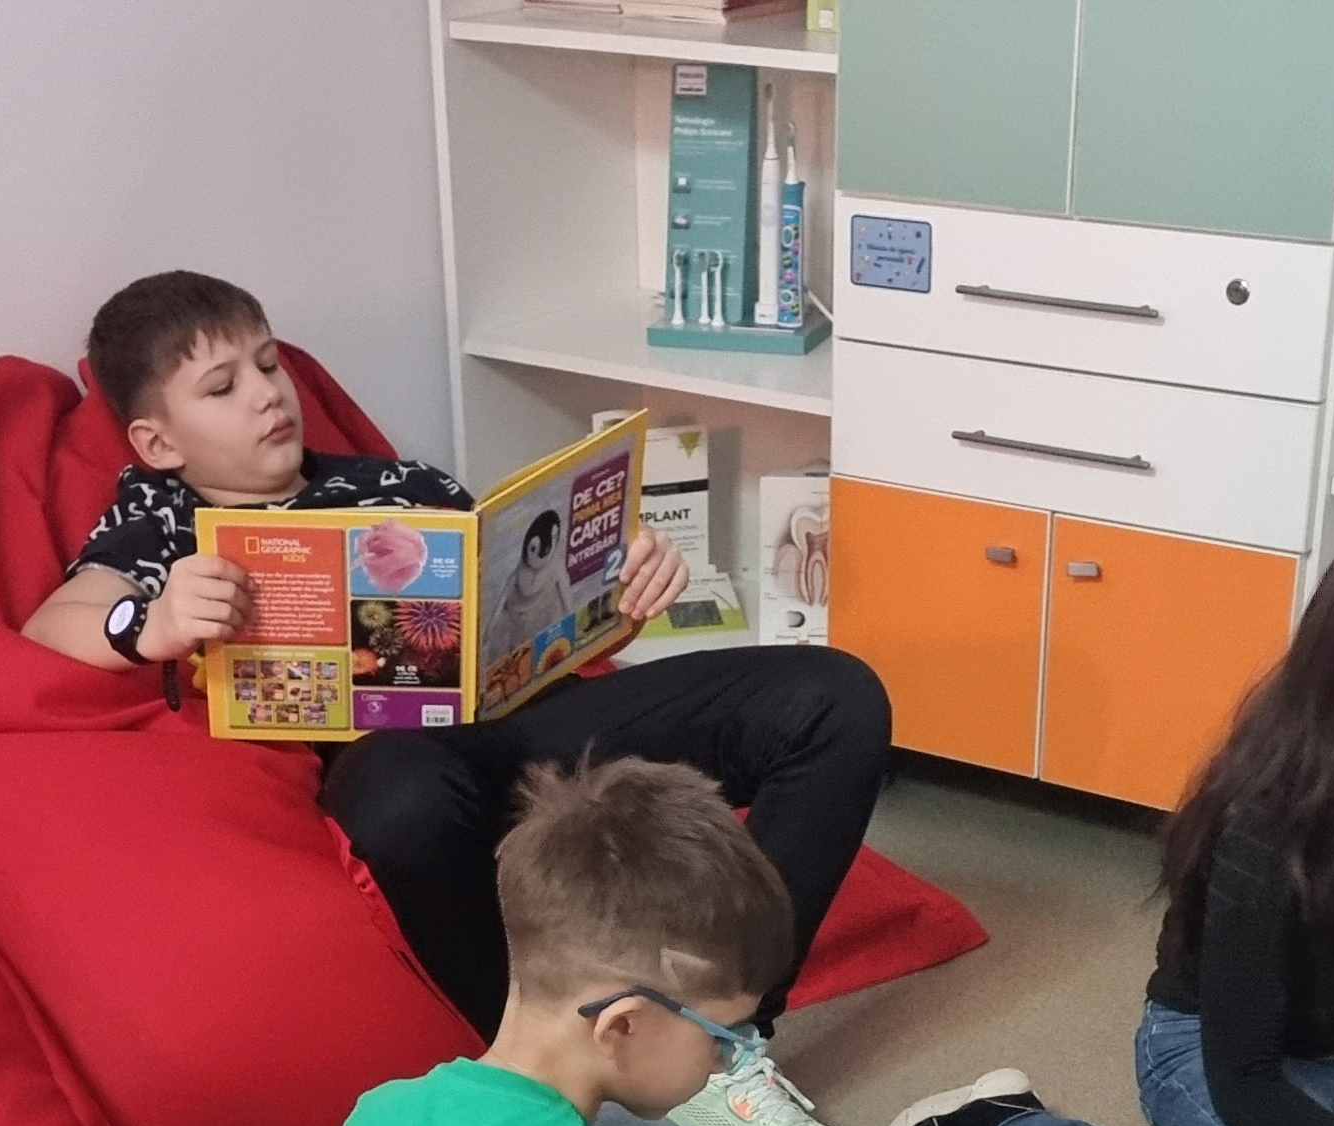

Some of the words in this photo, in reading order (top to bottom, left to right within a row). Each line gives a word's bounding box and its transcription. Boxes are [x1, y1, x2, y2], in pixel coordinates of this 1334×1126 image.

[572, 486, 594, 511] DE
[595, 470, 626, 498] CE?
[569, 505, 621, 548] CARTE
[604, 548, 623, 581] 2
